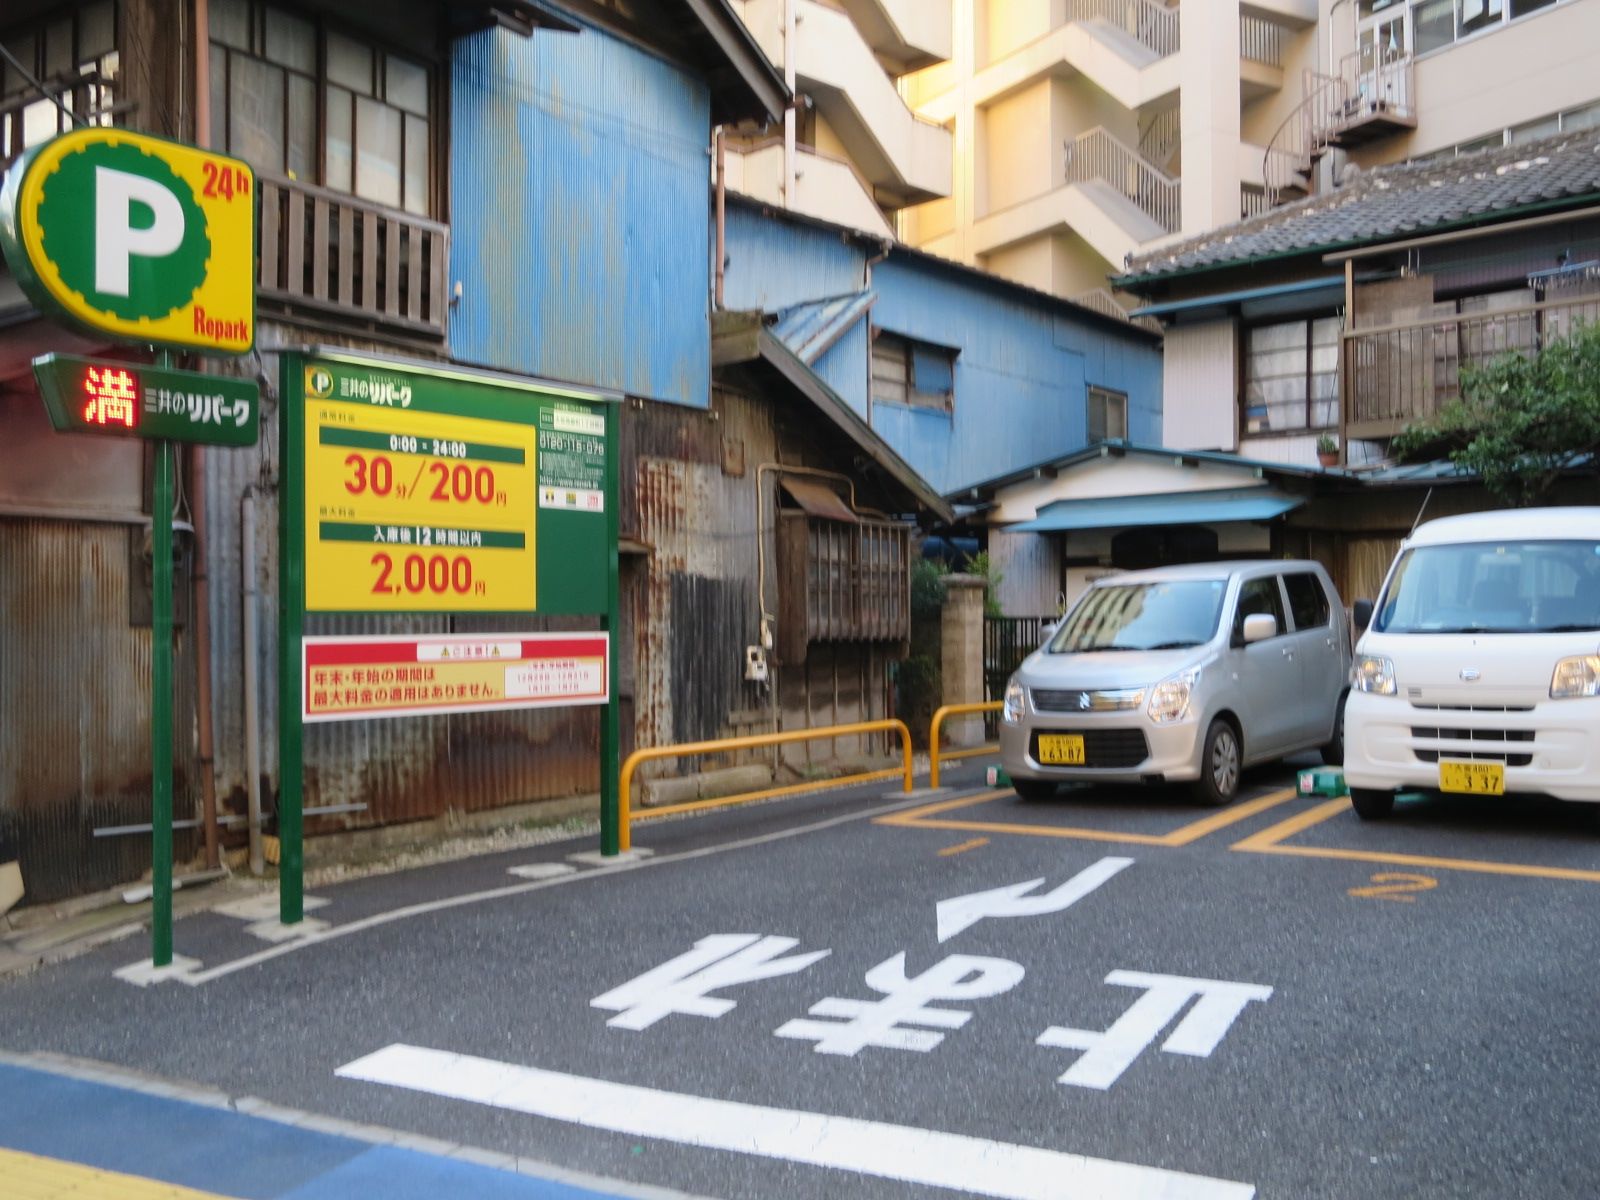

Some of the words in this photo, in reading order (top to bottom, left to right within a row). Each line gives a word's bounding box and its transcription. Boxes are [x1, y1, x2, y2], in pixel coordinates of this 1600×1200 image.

[203, 162, 249, 203] 24h
[95, 165, 186, 298] P
[193, 305, 248, 342] Repark
[83, 366, 136, 427] 満
[145, 388, 250, 427] 三井のリパーク
[340, 376, 412, 408] 三井のリパーク
[389, 434, 417, 453] 0:00
[433, 438, 467, 459] 24:00
[370, 551, 486, 596] 2,000円
[314, 667, 435, 688] 年末・年始の期間は
